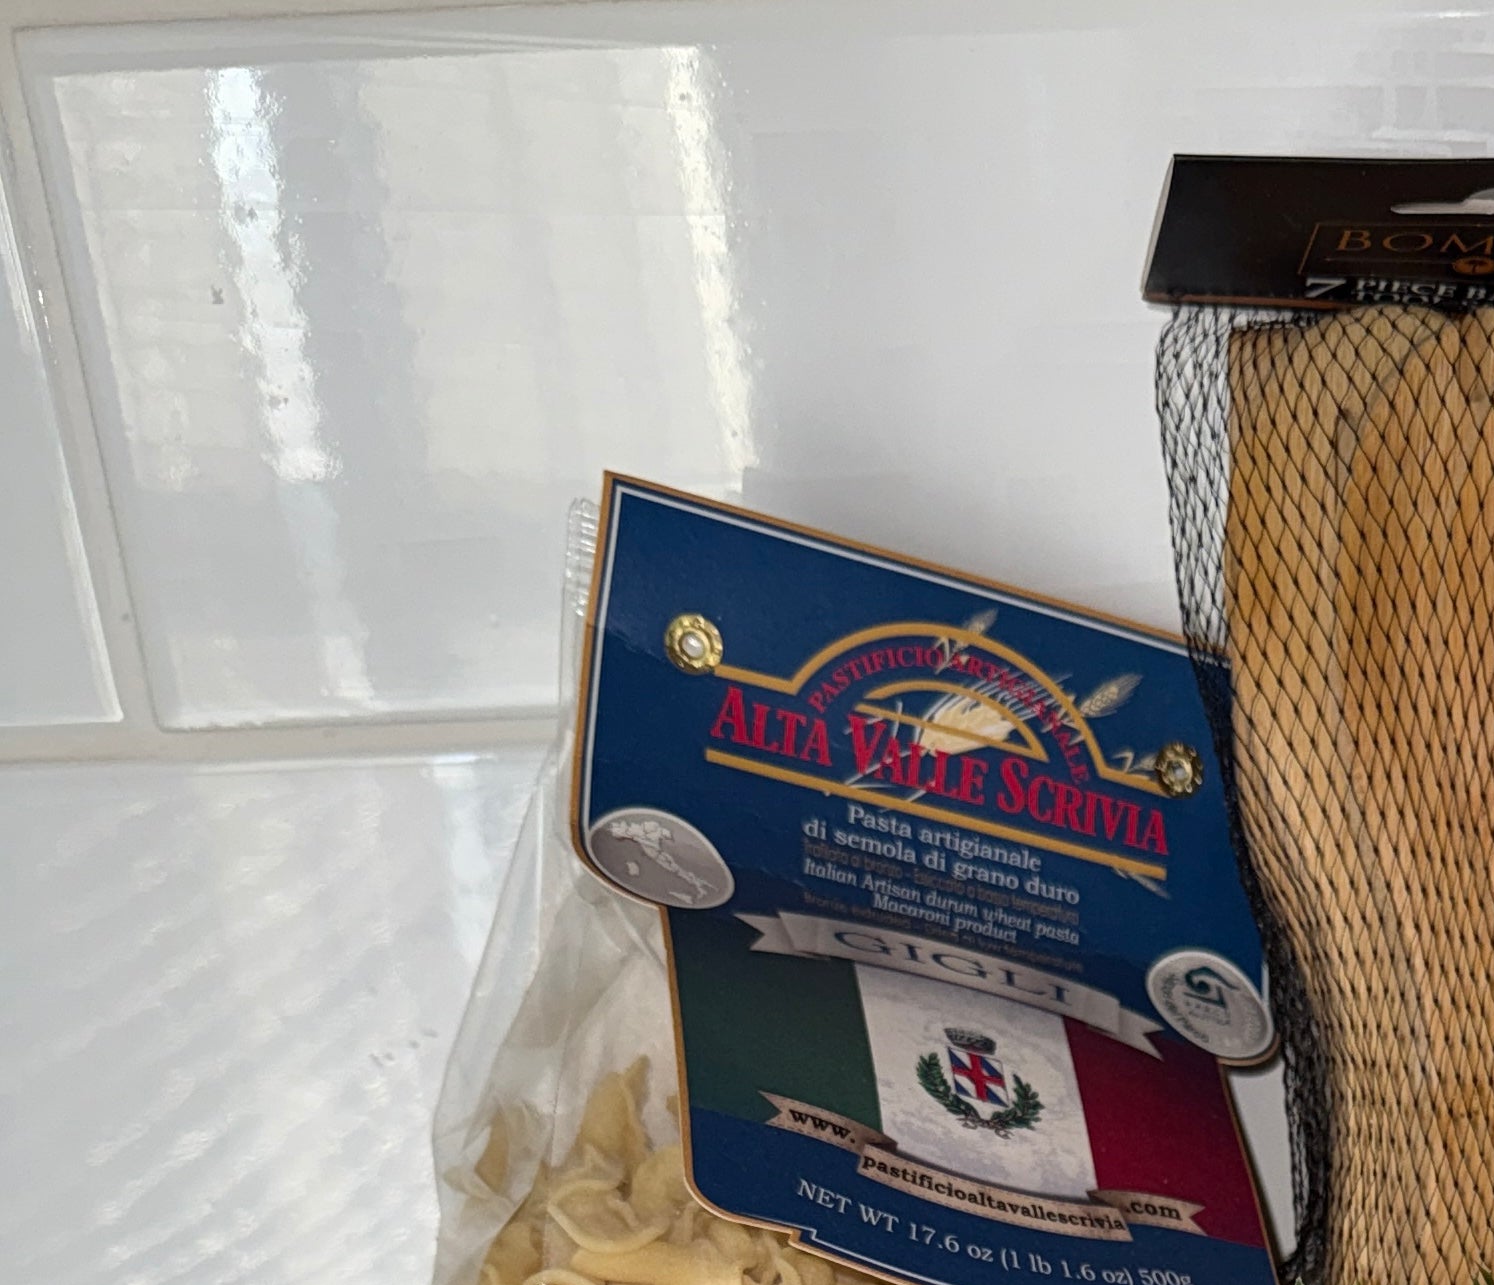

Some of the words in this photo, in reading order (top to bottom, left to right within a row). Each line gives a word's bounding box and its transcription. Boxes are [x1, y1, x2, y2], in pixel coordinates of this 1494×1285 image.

[1304, 276, 1348, 299] 7
[1355, 278, 1457, 300] PIECE
[807, 645, 945, 714] PASTIFICIO
[709, 686, 833, 768] ALTA
[849, 713, 990, 807] VALLE
[996, 756, 1170, 857] SCRIVIA
[802, 818, 827, 841] di
[833, 828, 917, 865] semola
[924, 850, 947, 873] di
[952, 860, 1020, 890] grano
[1024, 872, 1080, 905] duro
[847, 803, 912, 840] Pasta
[918, 829, 1042, 872] artigianale
[803, 858, 857, 887] Italian
[860, 873, 921, 907] Artisan
[925, 890, 979, 918] durum
[1035, 920, 1080, 946] pasta
[872, 893, 951, 927] Macaroni
[953, 914, 1018, 945] product
[833, 930, 1071, 1005] GIGLI
[797, 1178, 854, 1215] NET
[857, 1202, 901, 1234] WT
[907, 1221, 961, 1254] 17.6
[966, 1243, 995, 1263] oz
[1000, 1247, 1022, 1272] (1
[1028, 1253, 1053, 1277] lb
[1060, 1259, 1097, 1282] 1.6
